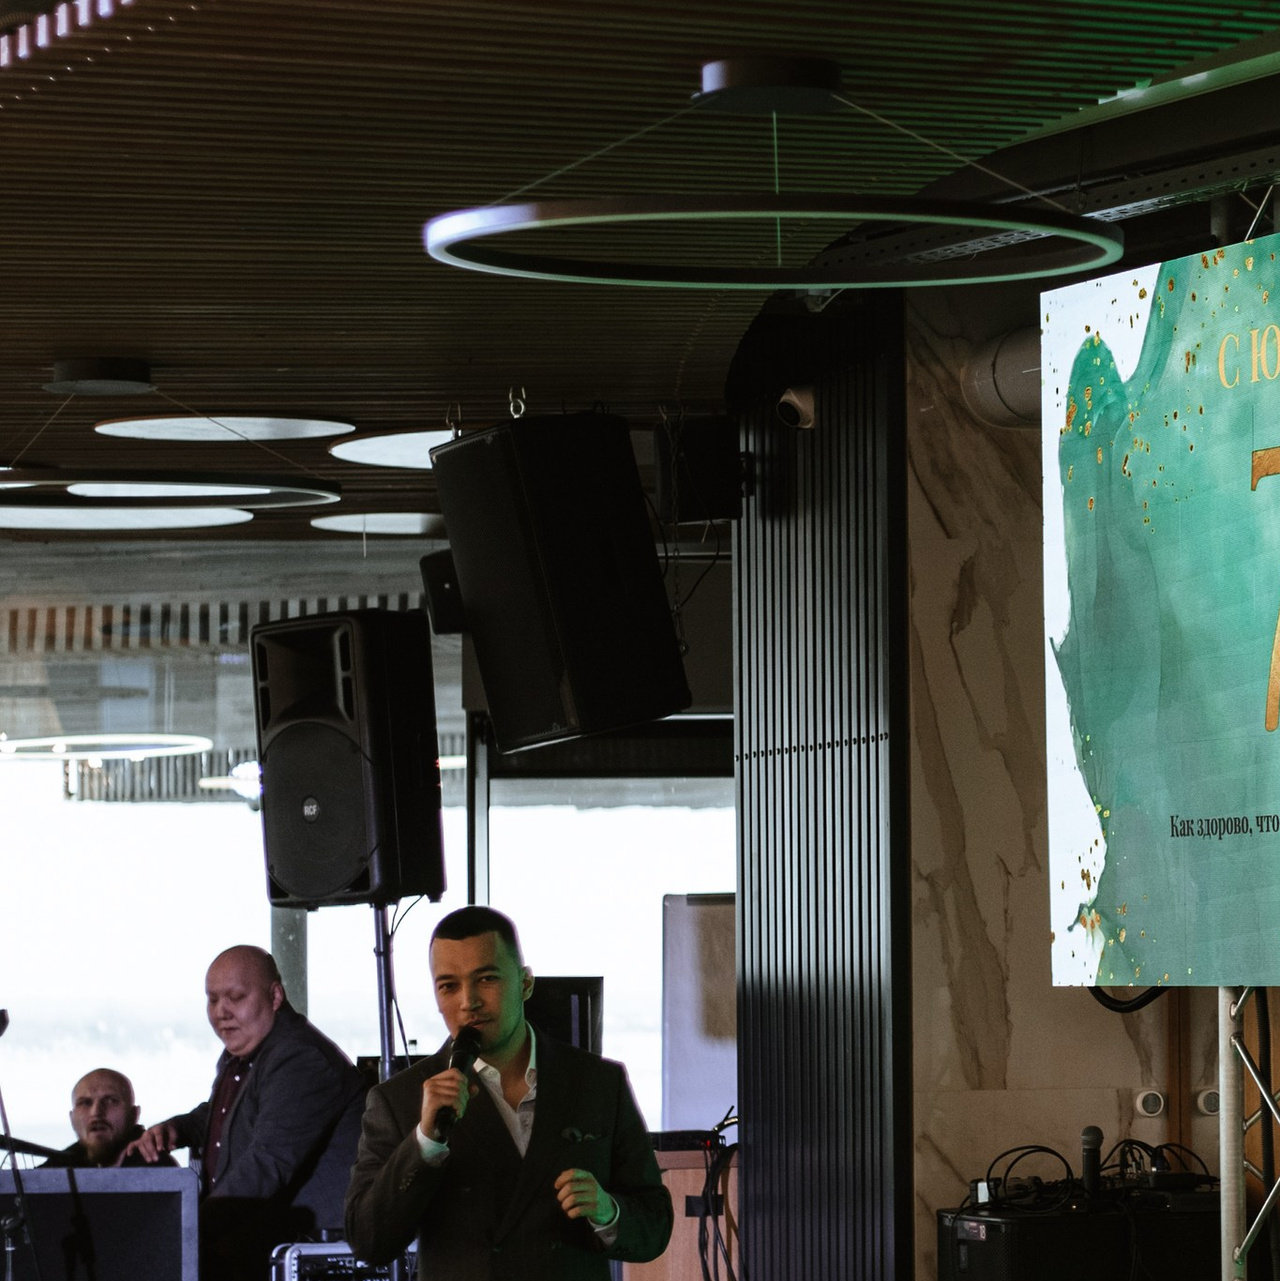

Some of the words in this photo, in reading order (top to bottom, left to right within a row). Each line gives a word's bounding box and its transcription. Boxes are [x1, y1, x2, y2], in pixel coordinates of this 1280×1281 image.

[1217, 332, 1240, 389] С
[303, 805, 318, 816] RCF
[1169, 815, 1194, 837] Как
[1197, 816, 1253, 840] здорово,
[1255, 814, 1280, 833] что
